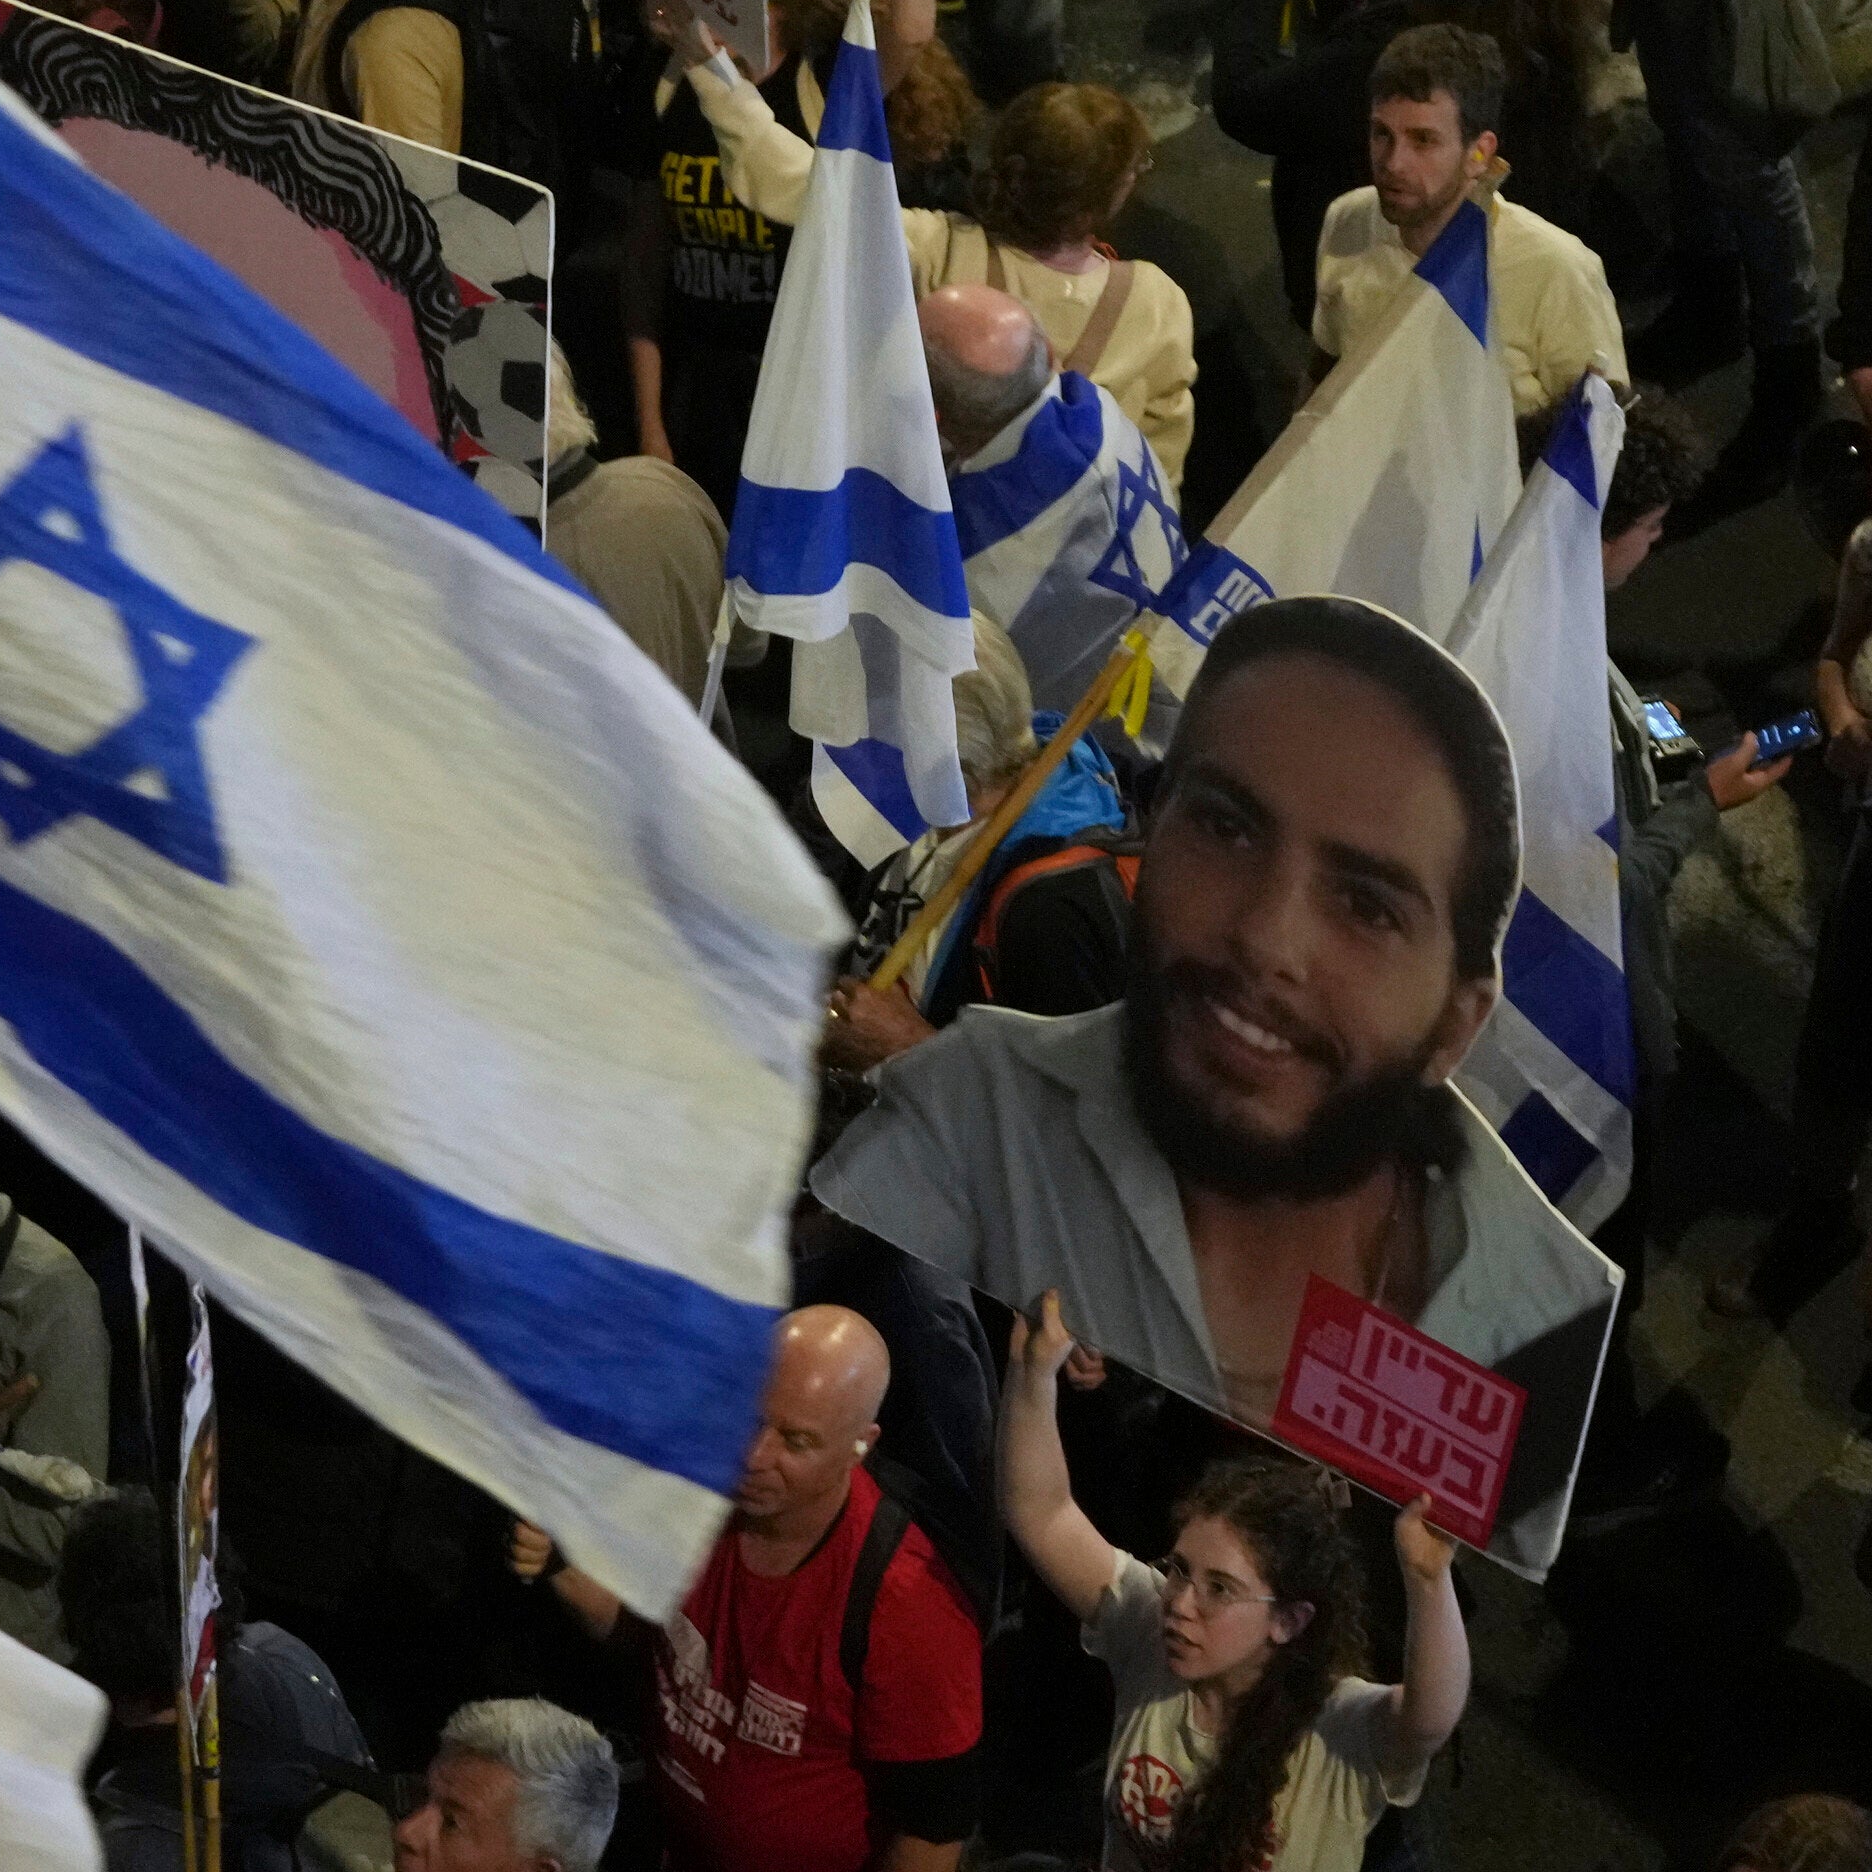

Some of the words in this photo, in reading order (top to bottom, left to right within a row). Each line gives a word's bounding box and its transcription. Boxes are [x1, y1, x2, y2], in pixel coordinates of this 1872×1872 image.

[659, 150, 721, 206] GET
[1363, 1325, 1508, 1436] עדיין
[1311, 1381, 1485, 1510] בעזה.
